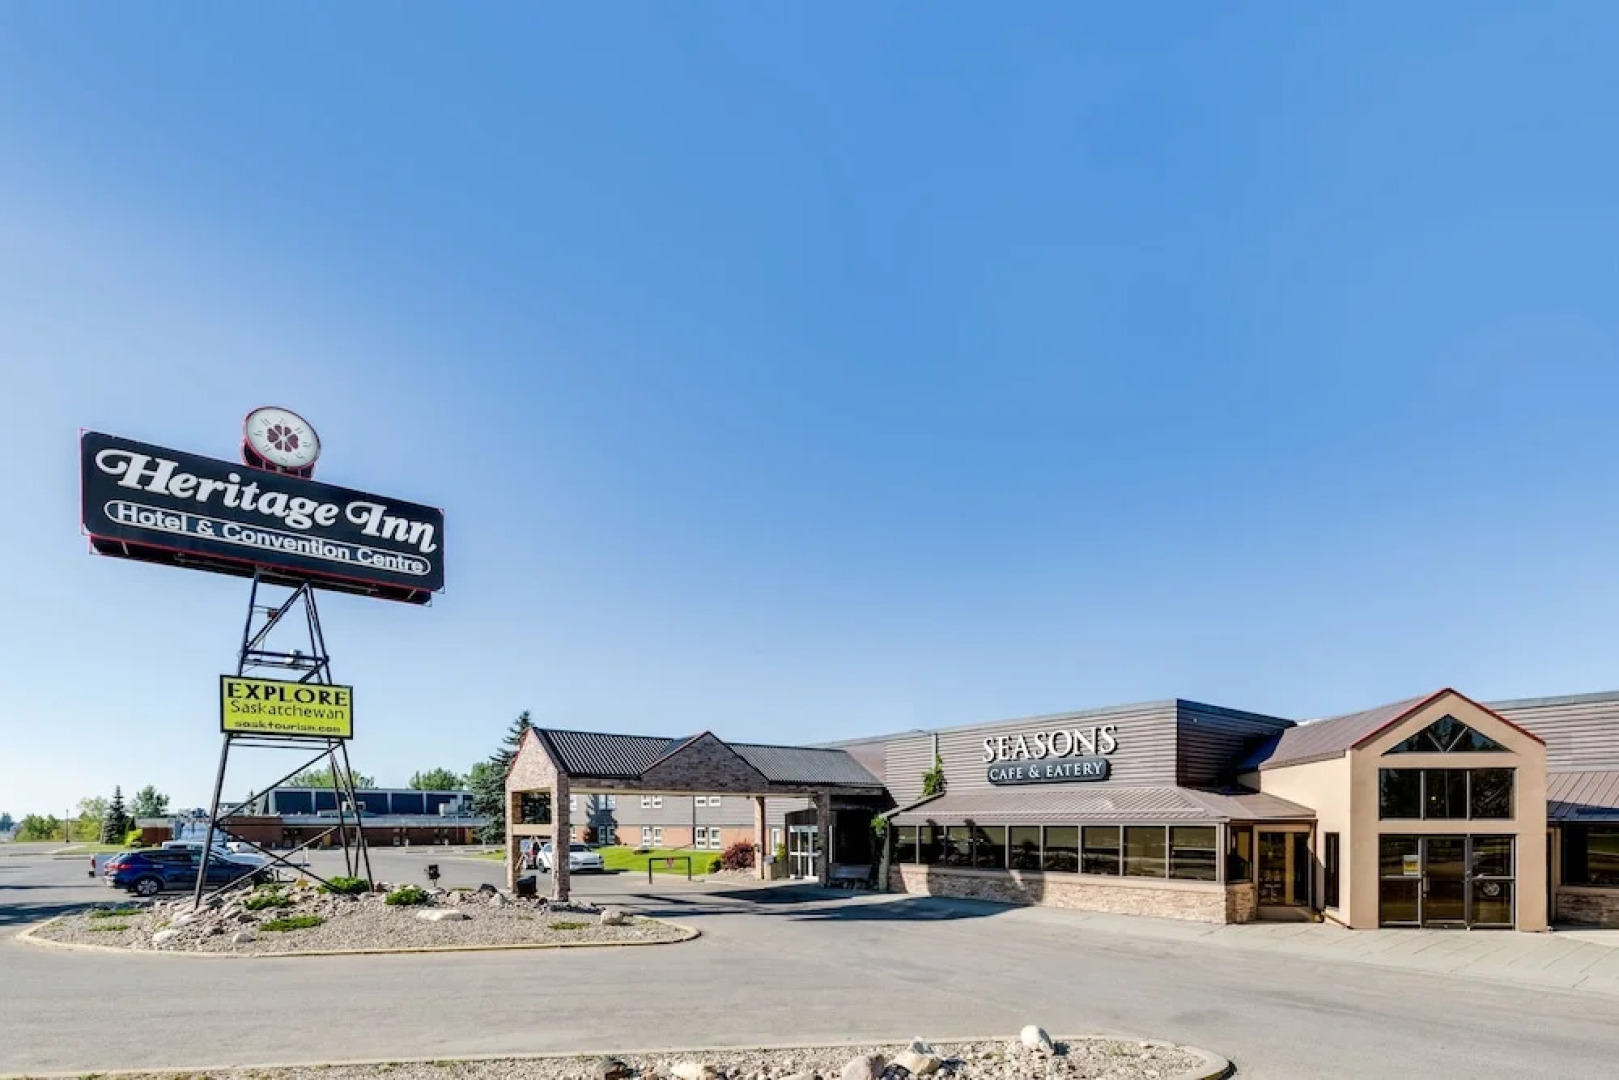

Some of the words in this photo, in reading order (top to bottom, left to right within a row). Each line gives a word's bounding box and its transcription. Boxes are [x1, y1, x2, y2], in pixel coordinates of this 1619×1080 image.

[95, 449, 338, 529] Heritage
[346, 501, 437, 553] Inn
[118, 503, 189, 532] Hotel
[196, 519, 216, 537] &
[223, 523, 350, 561] Convention
[357, 546, 424, 574] Centre
[227, 682, 348, 706] EXPLORE
[231, 700, 344, 719] Saskatchewan
[983, 725, 1117, 762] SEASONS
[990, 767, 1022, 780] CAFE
[1028, 764, 1040, 778] &
[1046, 762, 1103, 777] EATERY
